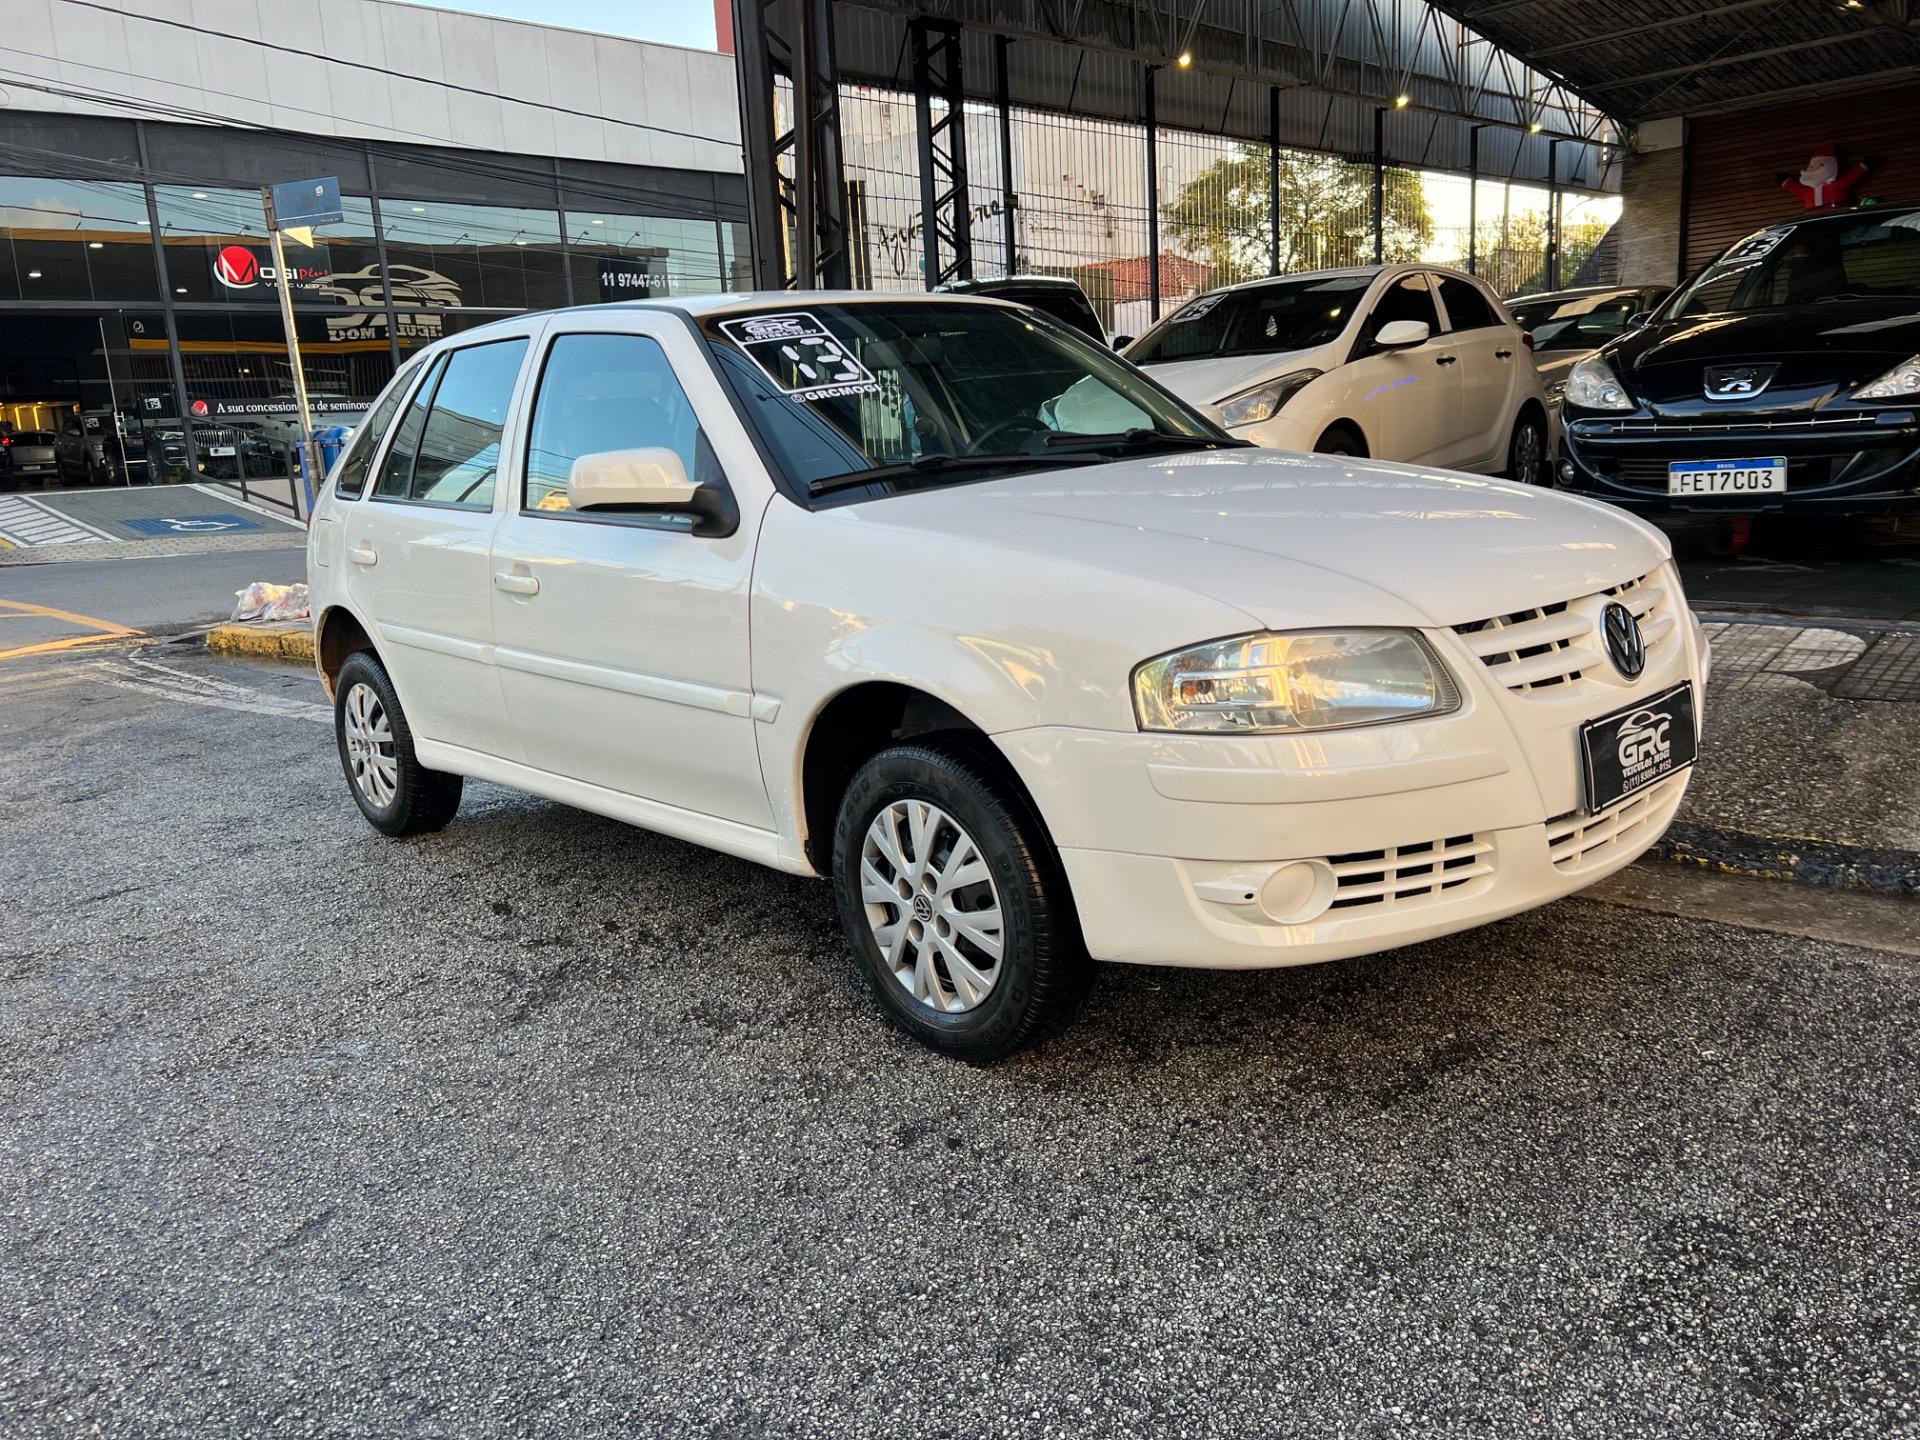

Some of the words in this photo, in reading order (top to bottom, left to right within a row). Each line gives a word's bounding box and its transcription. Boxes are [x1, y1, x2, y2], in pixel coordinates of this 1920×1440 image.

[602, 272, 615, 287] 11
[782, 337, 860, 381] 13
[217, 403, 226, 414] A
[317, 400, 328, 410] de
[1680, 470, 1773, 493] FET7C03
[1618, 720, 1671, 768] GRC
